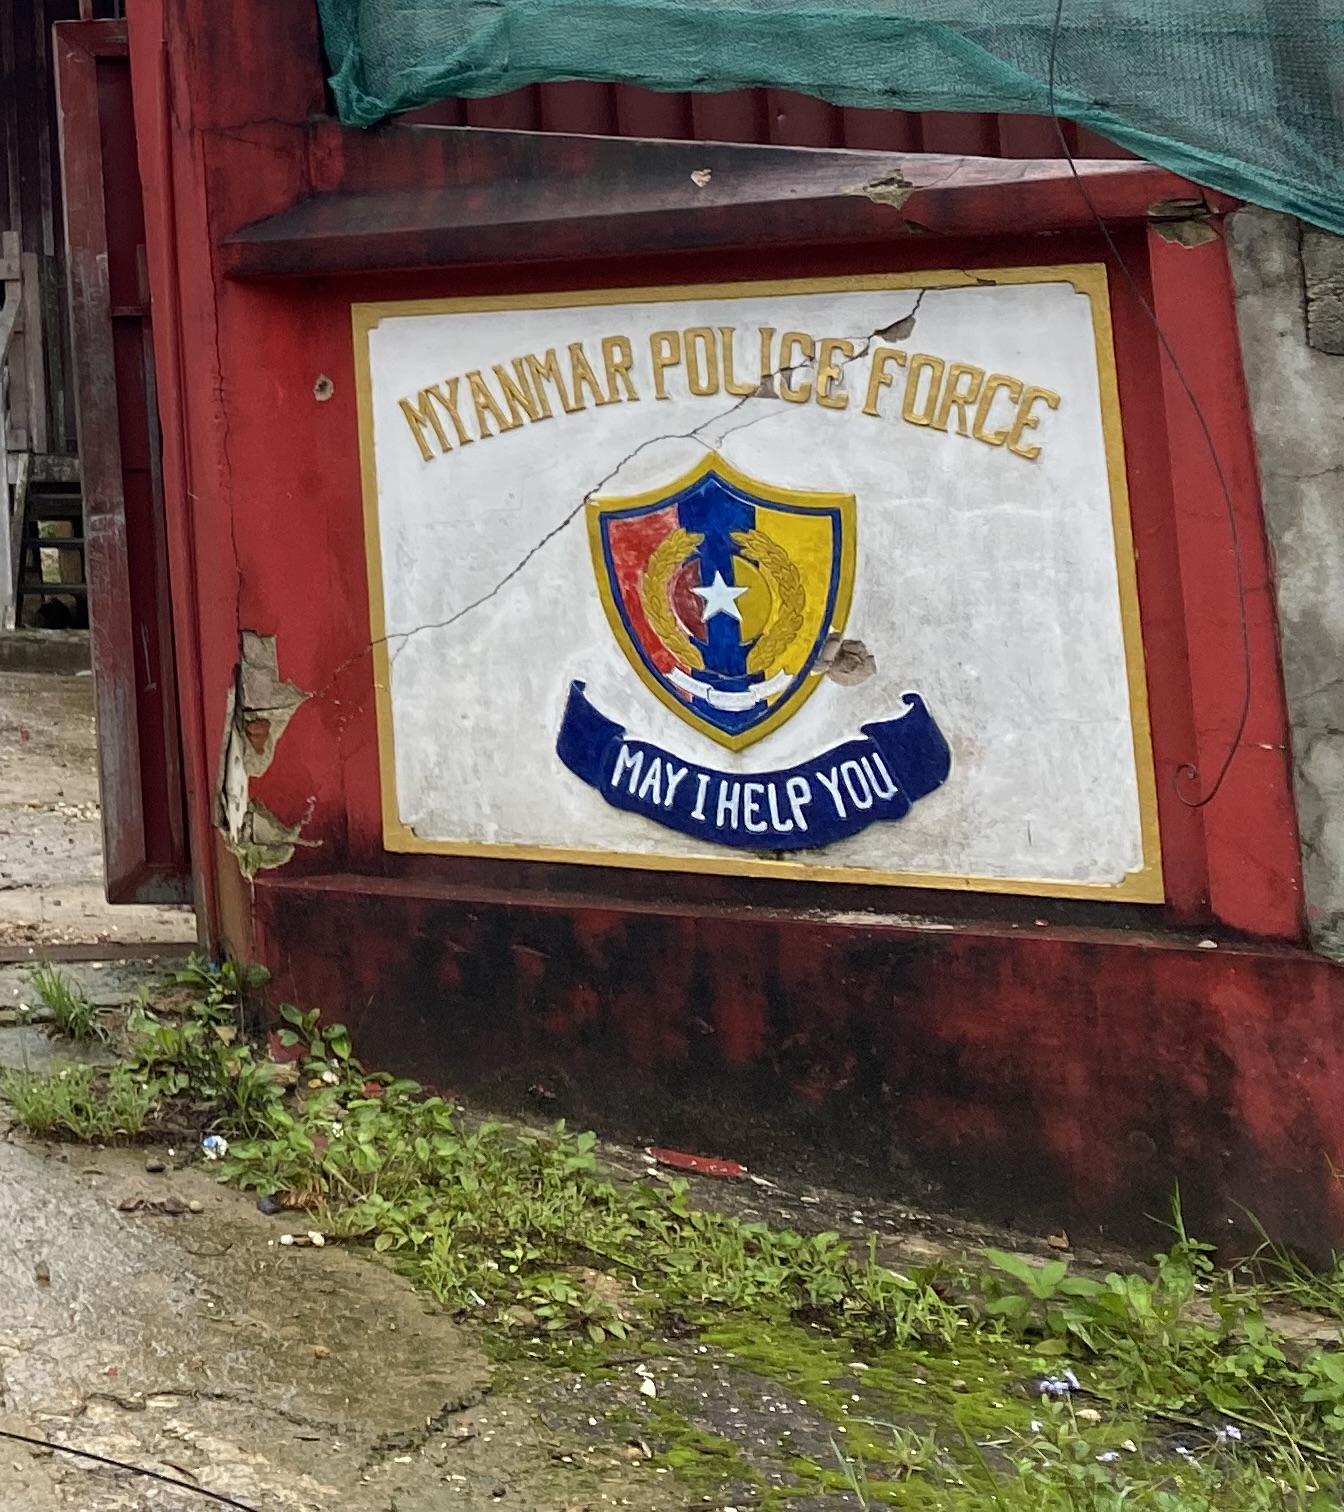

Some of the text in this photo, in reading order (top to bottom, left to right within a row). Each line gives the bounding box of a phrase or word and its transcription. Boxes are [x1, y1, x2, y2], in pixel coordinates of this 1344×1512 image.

[398, 326, 1062, 462] MYANMAR POLICE FORCE
[611, 744, 899, 833] MAY I HELP YOU
